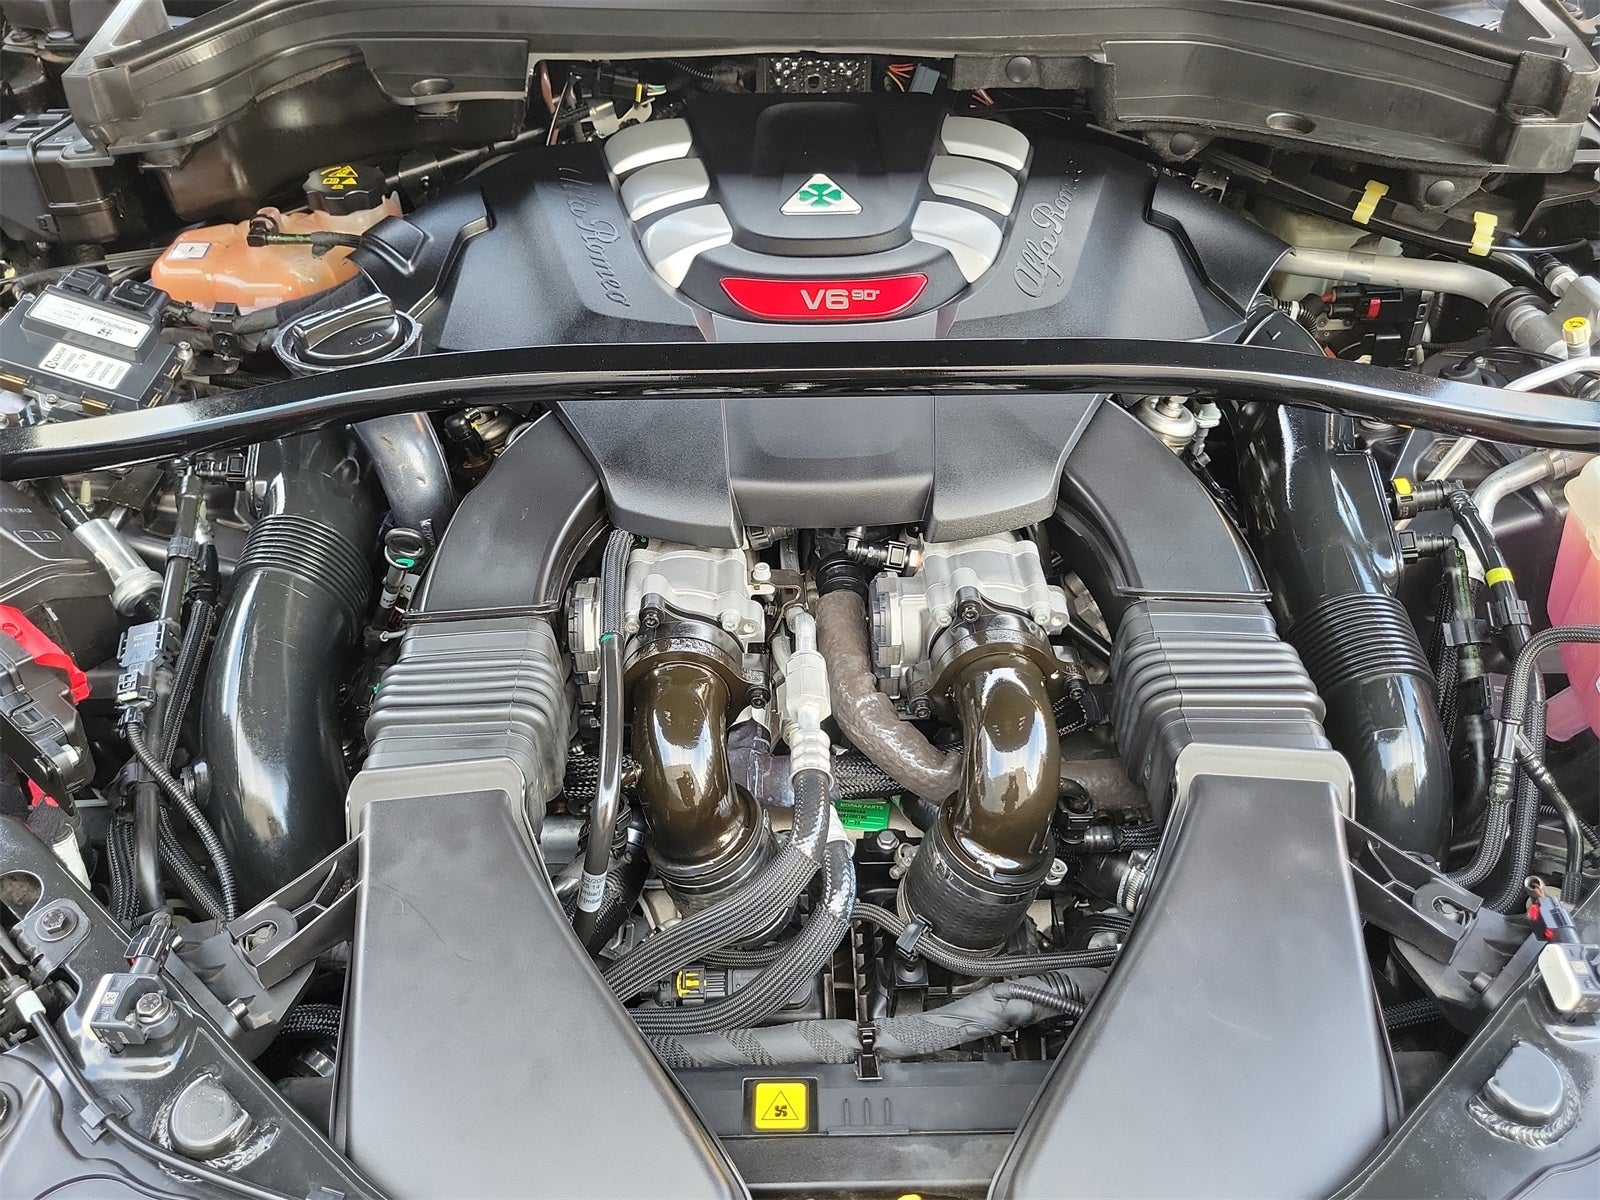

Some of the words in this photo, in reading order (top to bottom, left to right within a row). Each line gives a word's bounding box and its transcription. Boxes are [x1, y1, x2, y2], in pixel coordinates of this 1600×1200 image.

[1030, 156, 1083, 236] Rom
[575, 217, 632, 308] Romeo
[1014, 231, 1065, 298] Alfa
[800, 289, 850, 310] V6
